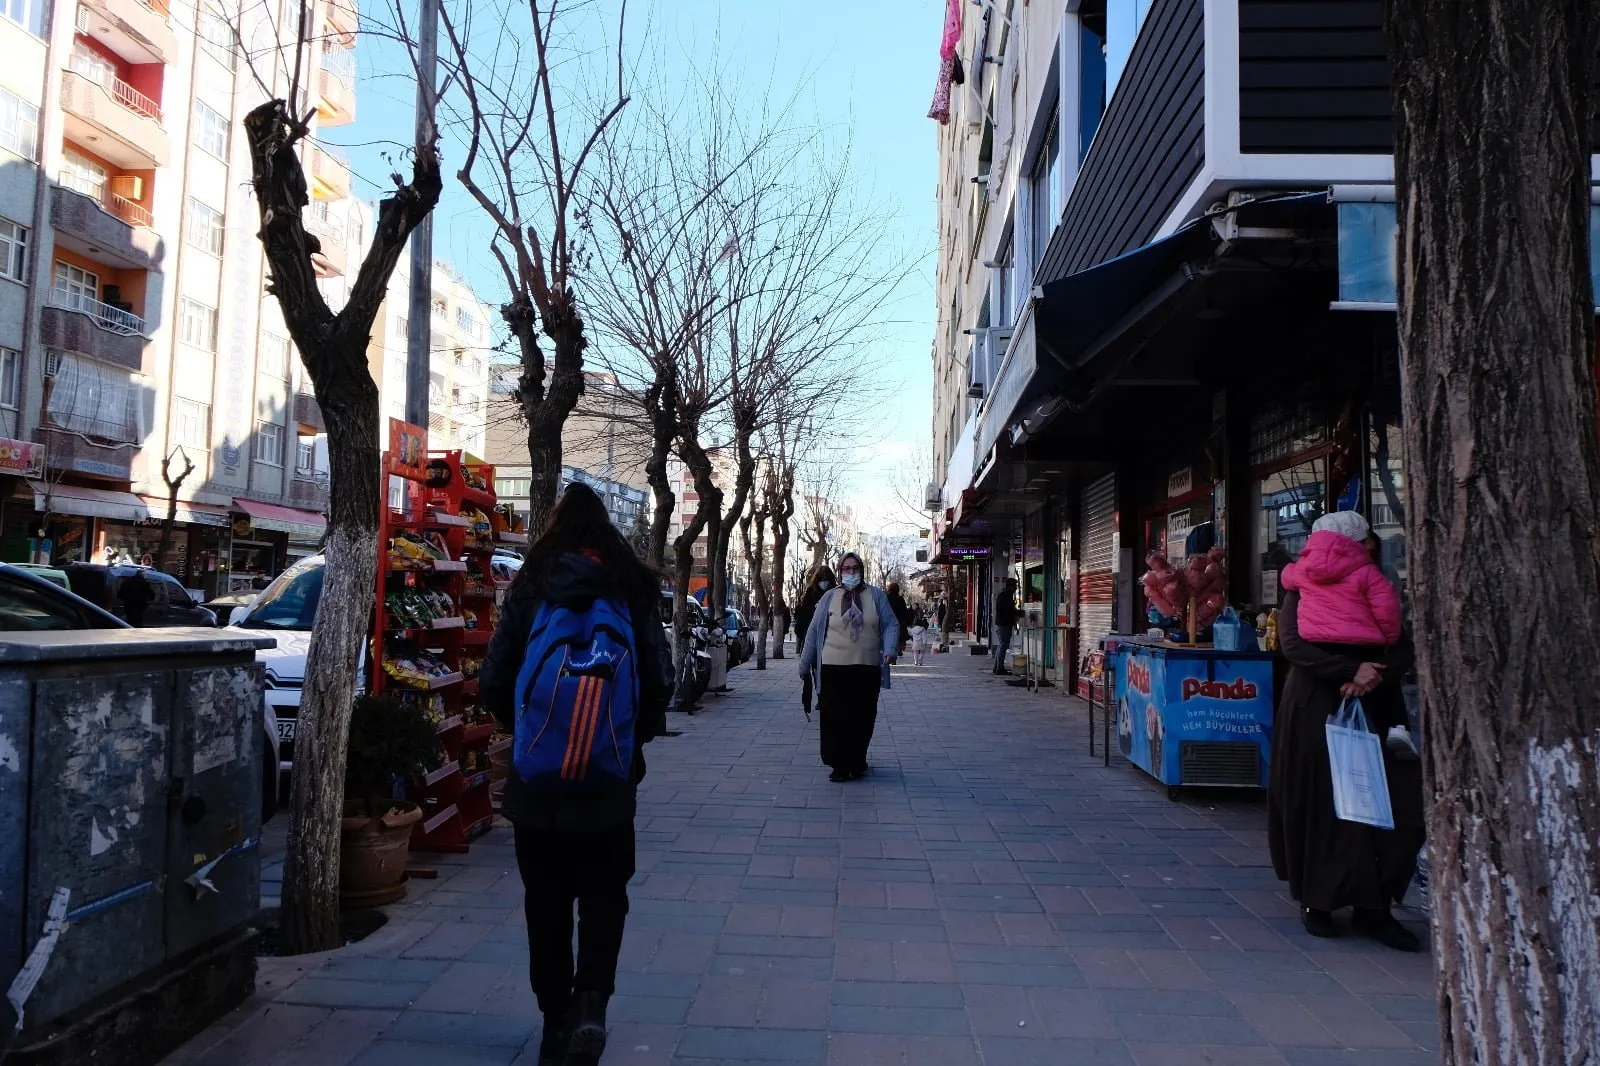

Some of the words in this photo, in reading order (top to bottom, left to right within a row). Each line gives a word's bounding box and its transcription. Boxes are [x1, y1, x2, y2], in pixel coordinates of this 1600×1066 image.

[1186, 709, 1206, 719] hem
[1209, 708, 1255, 721] küçüklere
[1182, 721, 1202, 733] HEM
[1206, 720, 1263, 735] BÜYÜKLERE
